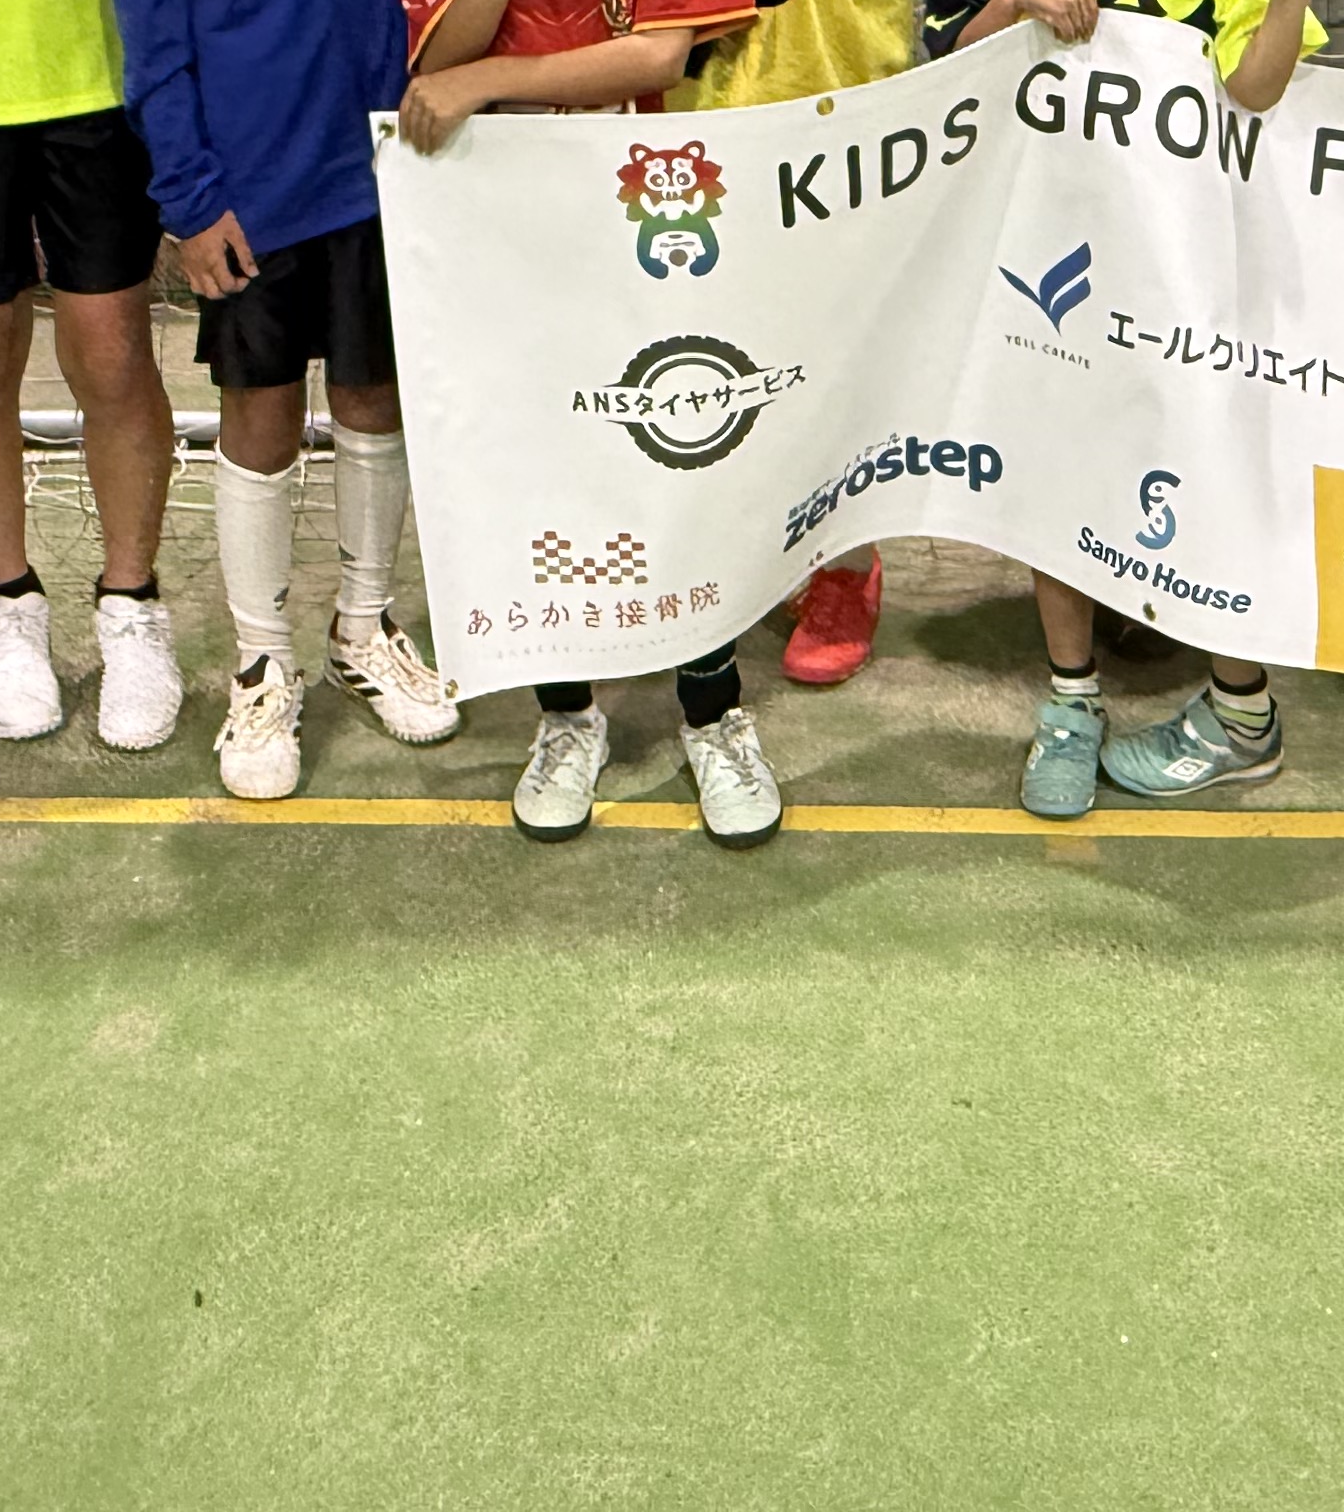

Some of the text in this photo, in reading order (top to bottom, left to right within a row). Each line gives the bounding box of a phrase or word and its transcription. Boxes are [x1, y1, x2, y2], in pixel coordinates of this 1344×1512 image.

[778, 96, 981, 230] KIDS
[1014, 60, 1263, 184] GROW
[572, 365, 807, 416] ANSタイヤサービス
[783, 436, 1004, 553] zerostep
[467, 581, 721, 637] あらかき接骨院
[1077, 526, 1253, 614] Sanyo House
